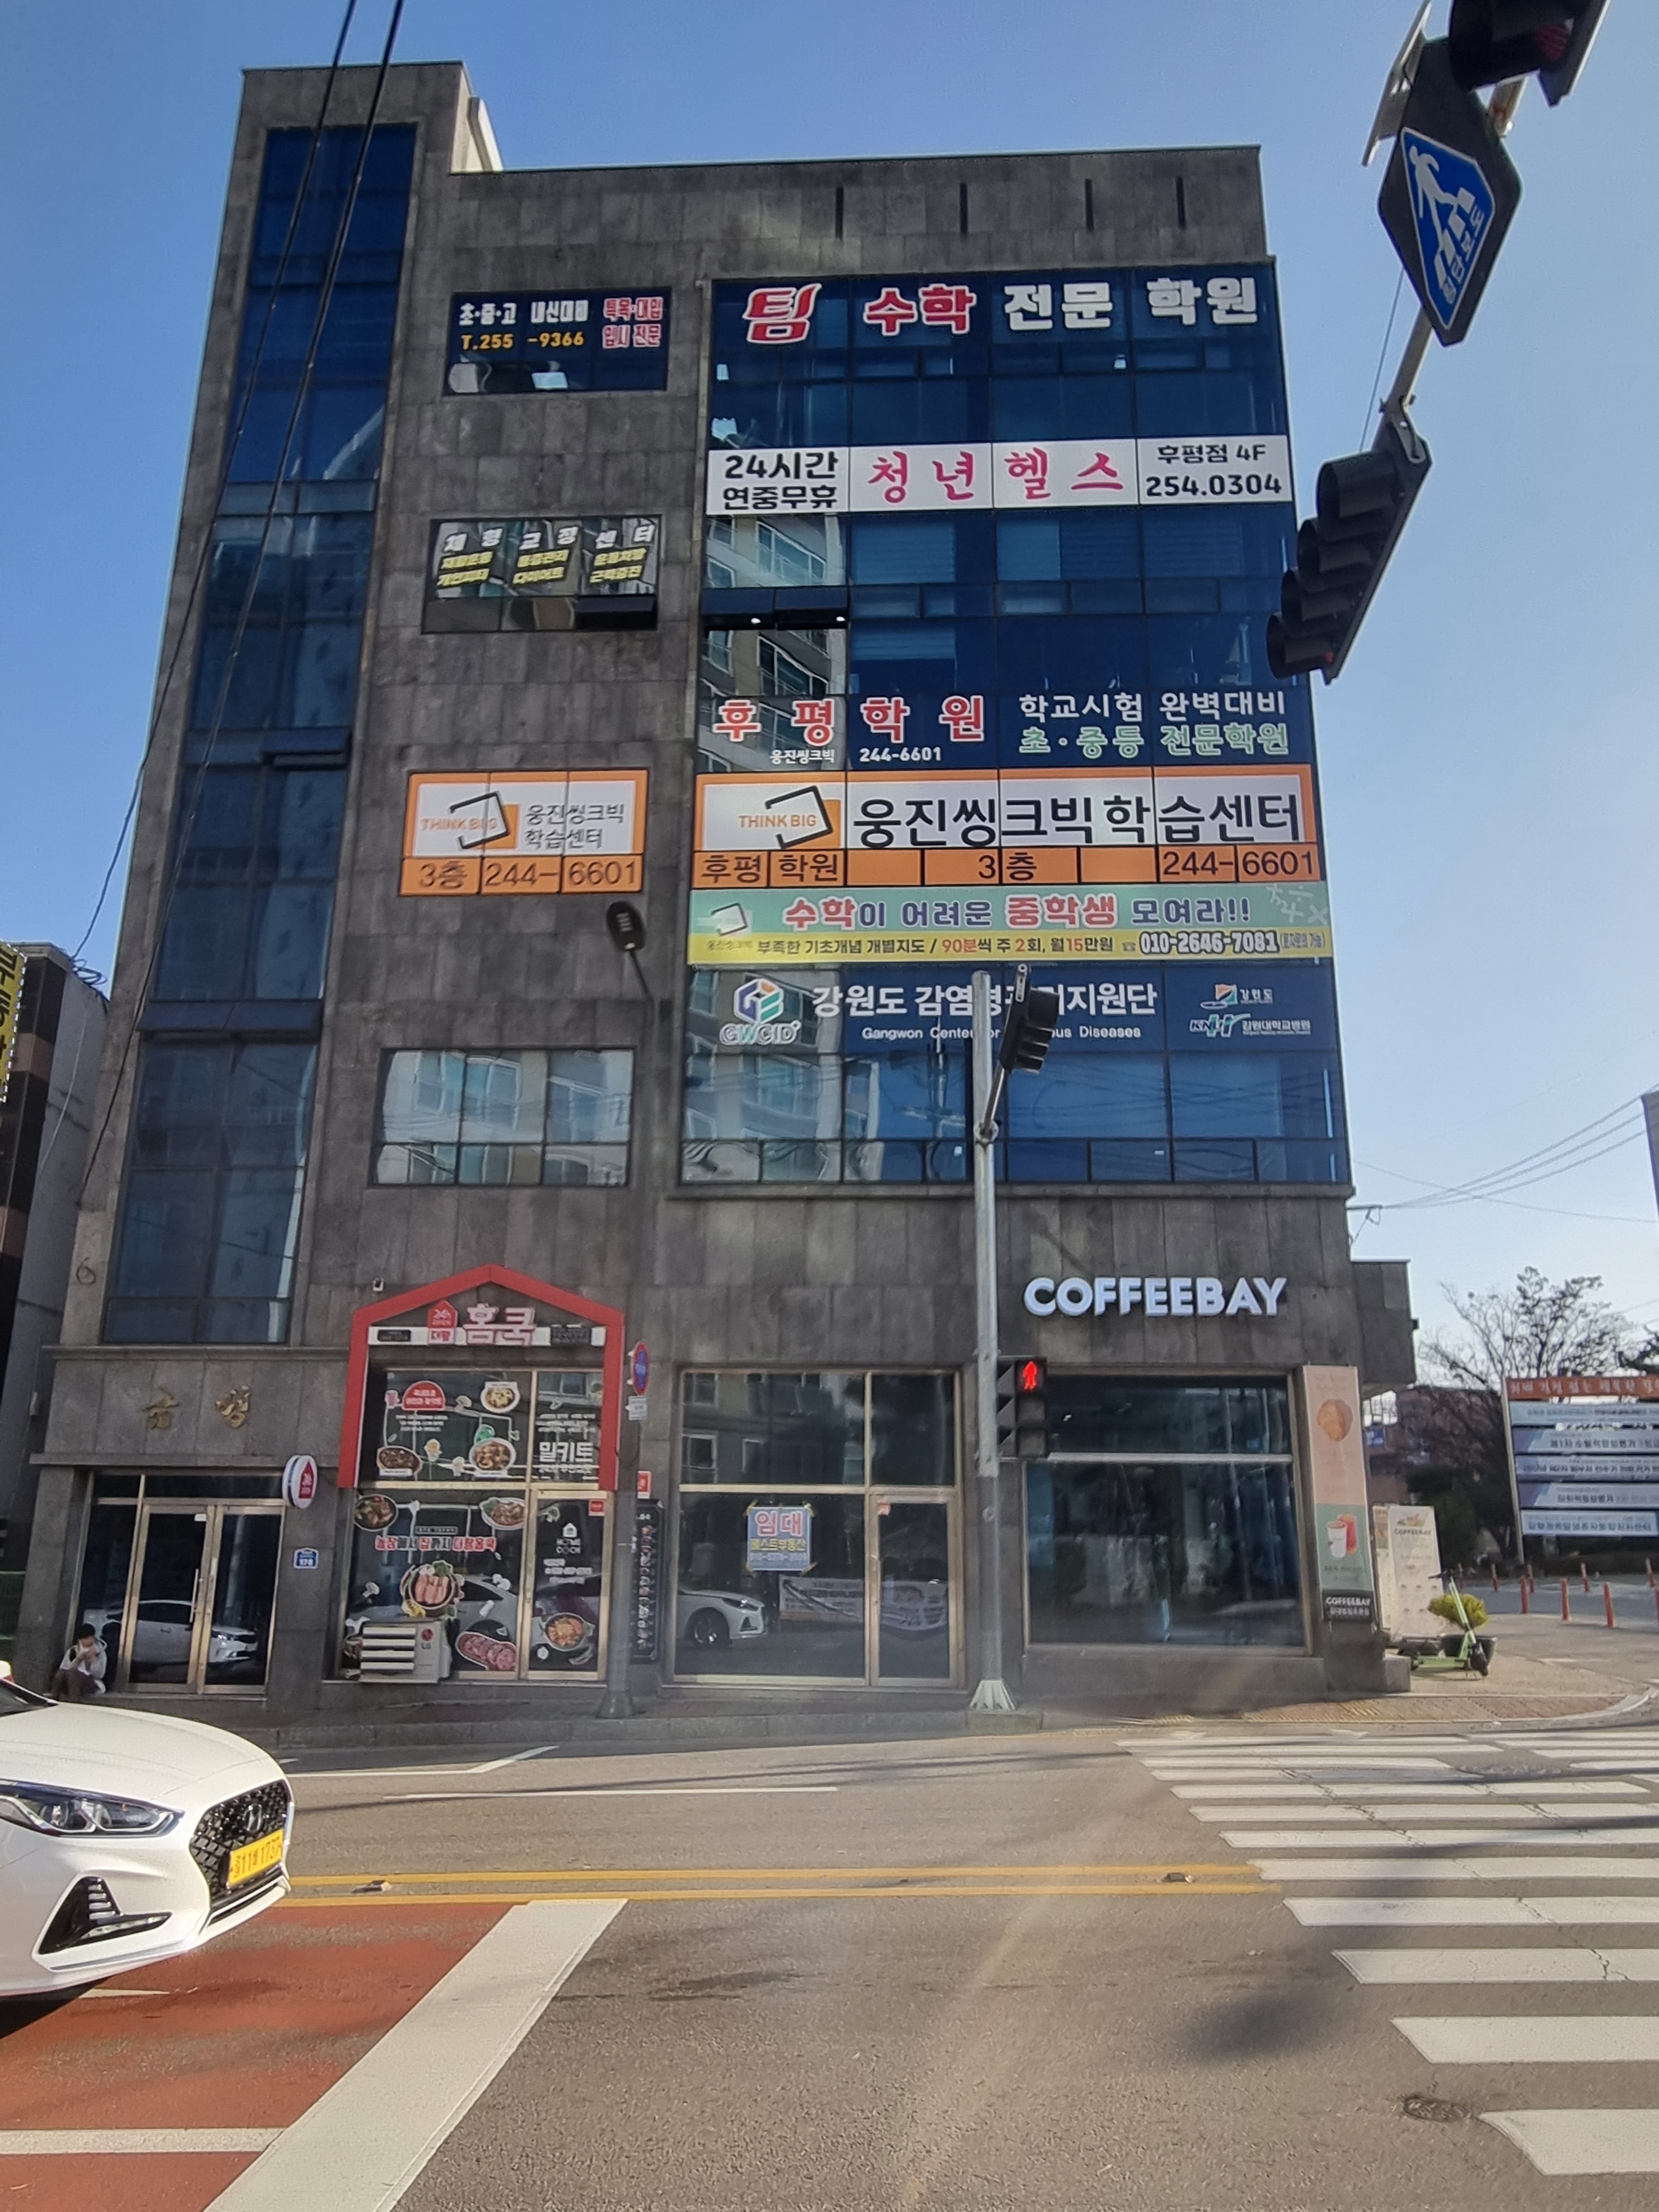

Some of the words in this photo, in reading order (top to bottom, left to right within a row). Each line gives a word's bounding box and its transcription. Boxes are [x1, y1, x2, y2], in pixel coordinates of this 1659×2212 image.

[742, 283, 822, 344] 팀
[863, 283, 977, 336] 수학
[1004, 282, 1113, 330] 전문
[1147, 277, 1257, 325] 학원
[602, 325, 630, 348] 입시
[633, 323, 662, 347] 전문
[725, 451, 838, 479] 24시간
[1155, 444, 1227, 463] 후평점
[1235, 444, 1266, 458] 4F
[723, 484, 838, 510] 연중무휴
[1146, 473, 1282, 496] 254.0304
[1019, 692, 1143, 723] 학교시험
[1159, 691, 1285, 721] 완벽대비
[1160, 721, 1289, 756] 전문학원
[770, 750, 835, 765] 웅진씽크빅
[859, 747, 941, 762] 244-6601
[422, 817, 467, 831] THINK
[524, 804, 624, 825] 웅진씽크빅
[738, 815, 787, 828] THINK
[789, 814, 817, 827] BIG
[524, 828, 603, 849] 학습센터
[420, 861, 467, 889] 3층
[485, 861, 635, 888] 244-6601
[1163, 850, 1313, 876] 244-6601
[782, 897, 887, 932] 수학이
[901, 900, 992, 927] 어려운
[1006, 893, 1118, 929] 중학생
[1131, 897, 1251, 924] 모여라!!
[758, 940, 800, 955] 부족한
[805, 940, 861, 954] 기초개념
[867, 939, 925, 953] 개별지도
[942, 938, 991, 953] 90분씩
[997, 938, 1011, 952] 주
[1139, 932, 1280, 955] 010-2646-7081
[813, 985, 906, 1017] 강원도
[862, 1028, 923, 1040] Gangwon
[1024, 1277, 1287, 1316] COFFEEBAY
[463, 1303, 536, 1346] 홈쿡
[539, 1442, 594, 1463] 밀키트
[755, 1511, 803, 1537] 임대
